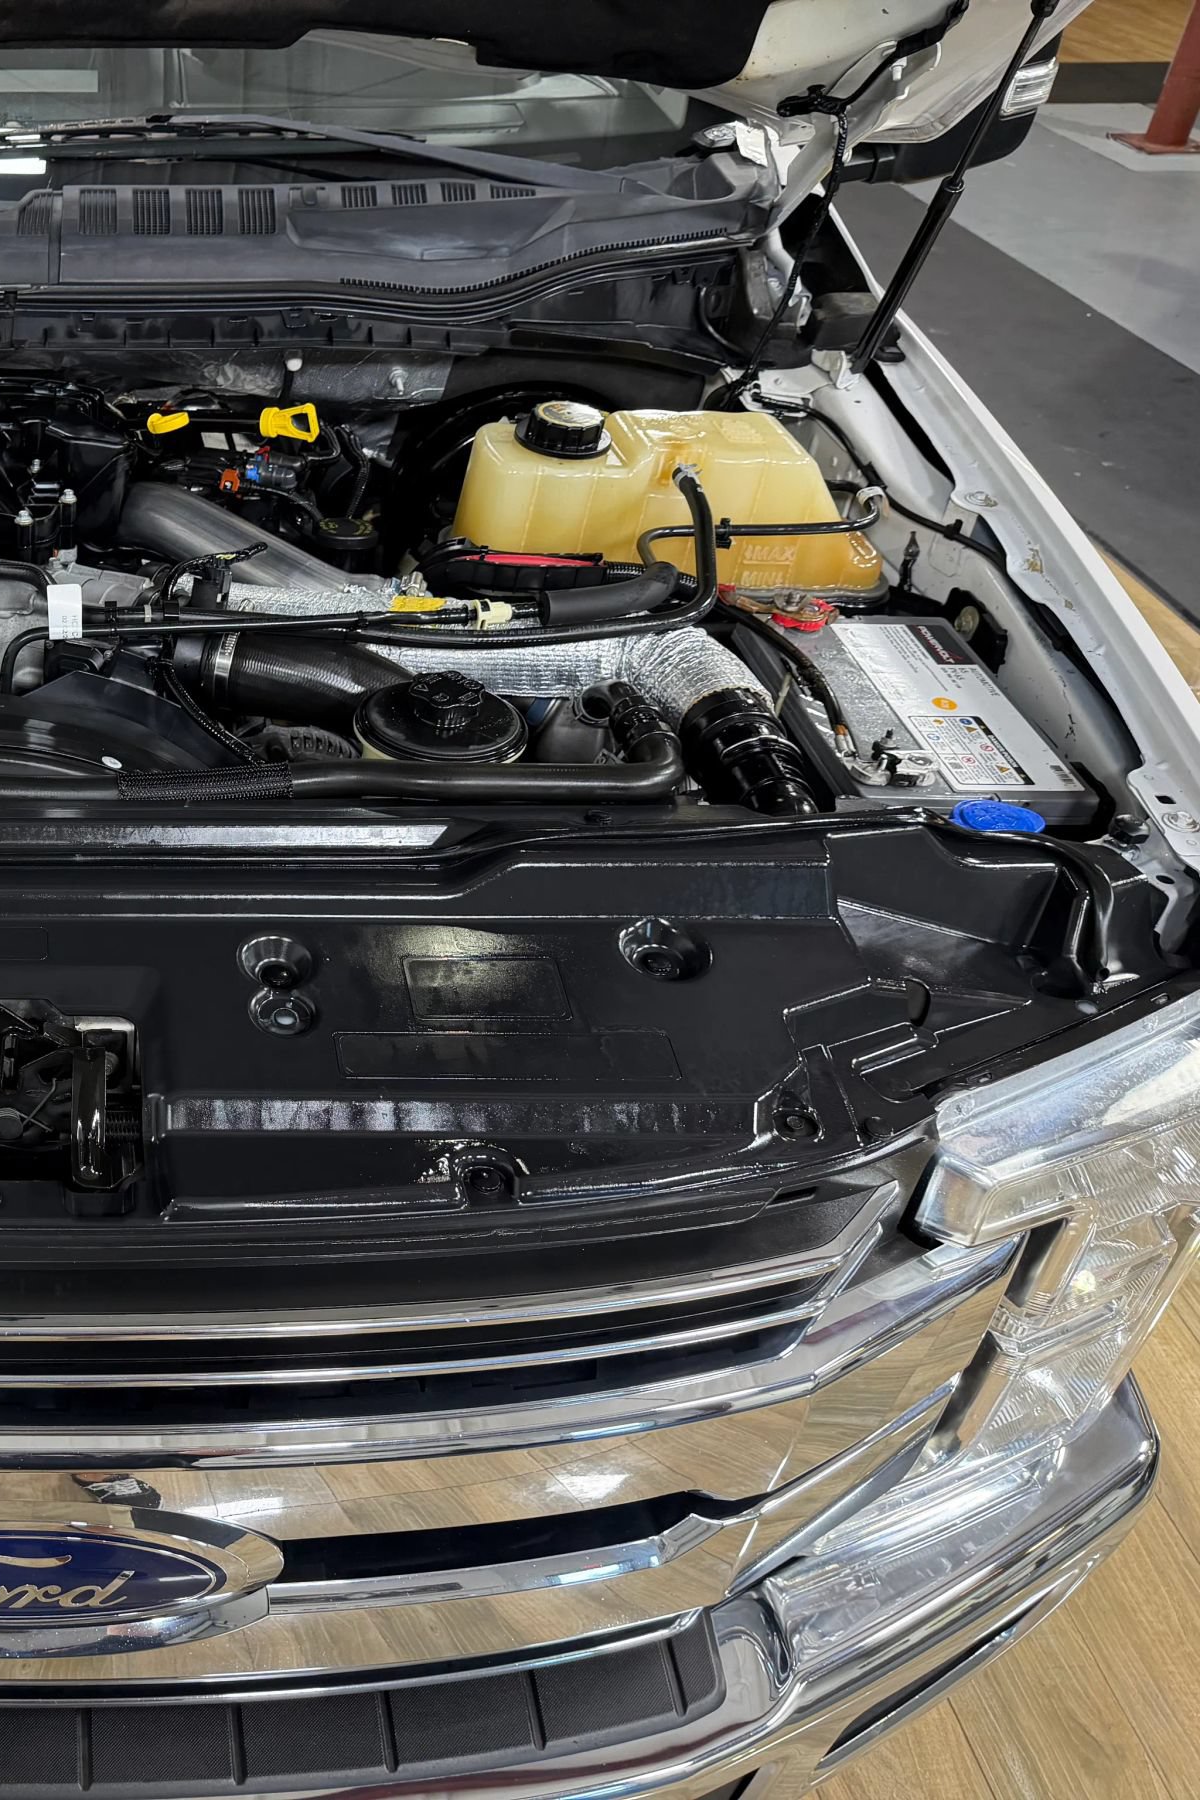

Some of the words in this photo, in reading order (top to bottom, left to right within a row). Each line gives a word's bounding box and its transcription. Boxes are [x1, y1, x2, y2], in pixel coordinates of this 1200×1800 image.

[753, 545, 796, 560] MAX
[741, 571, 775, 586] MIN
[969, 667, 1000, 697] AUTOMOTIVE
